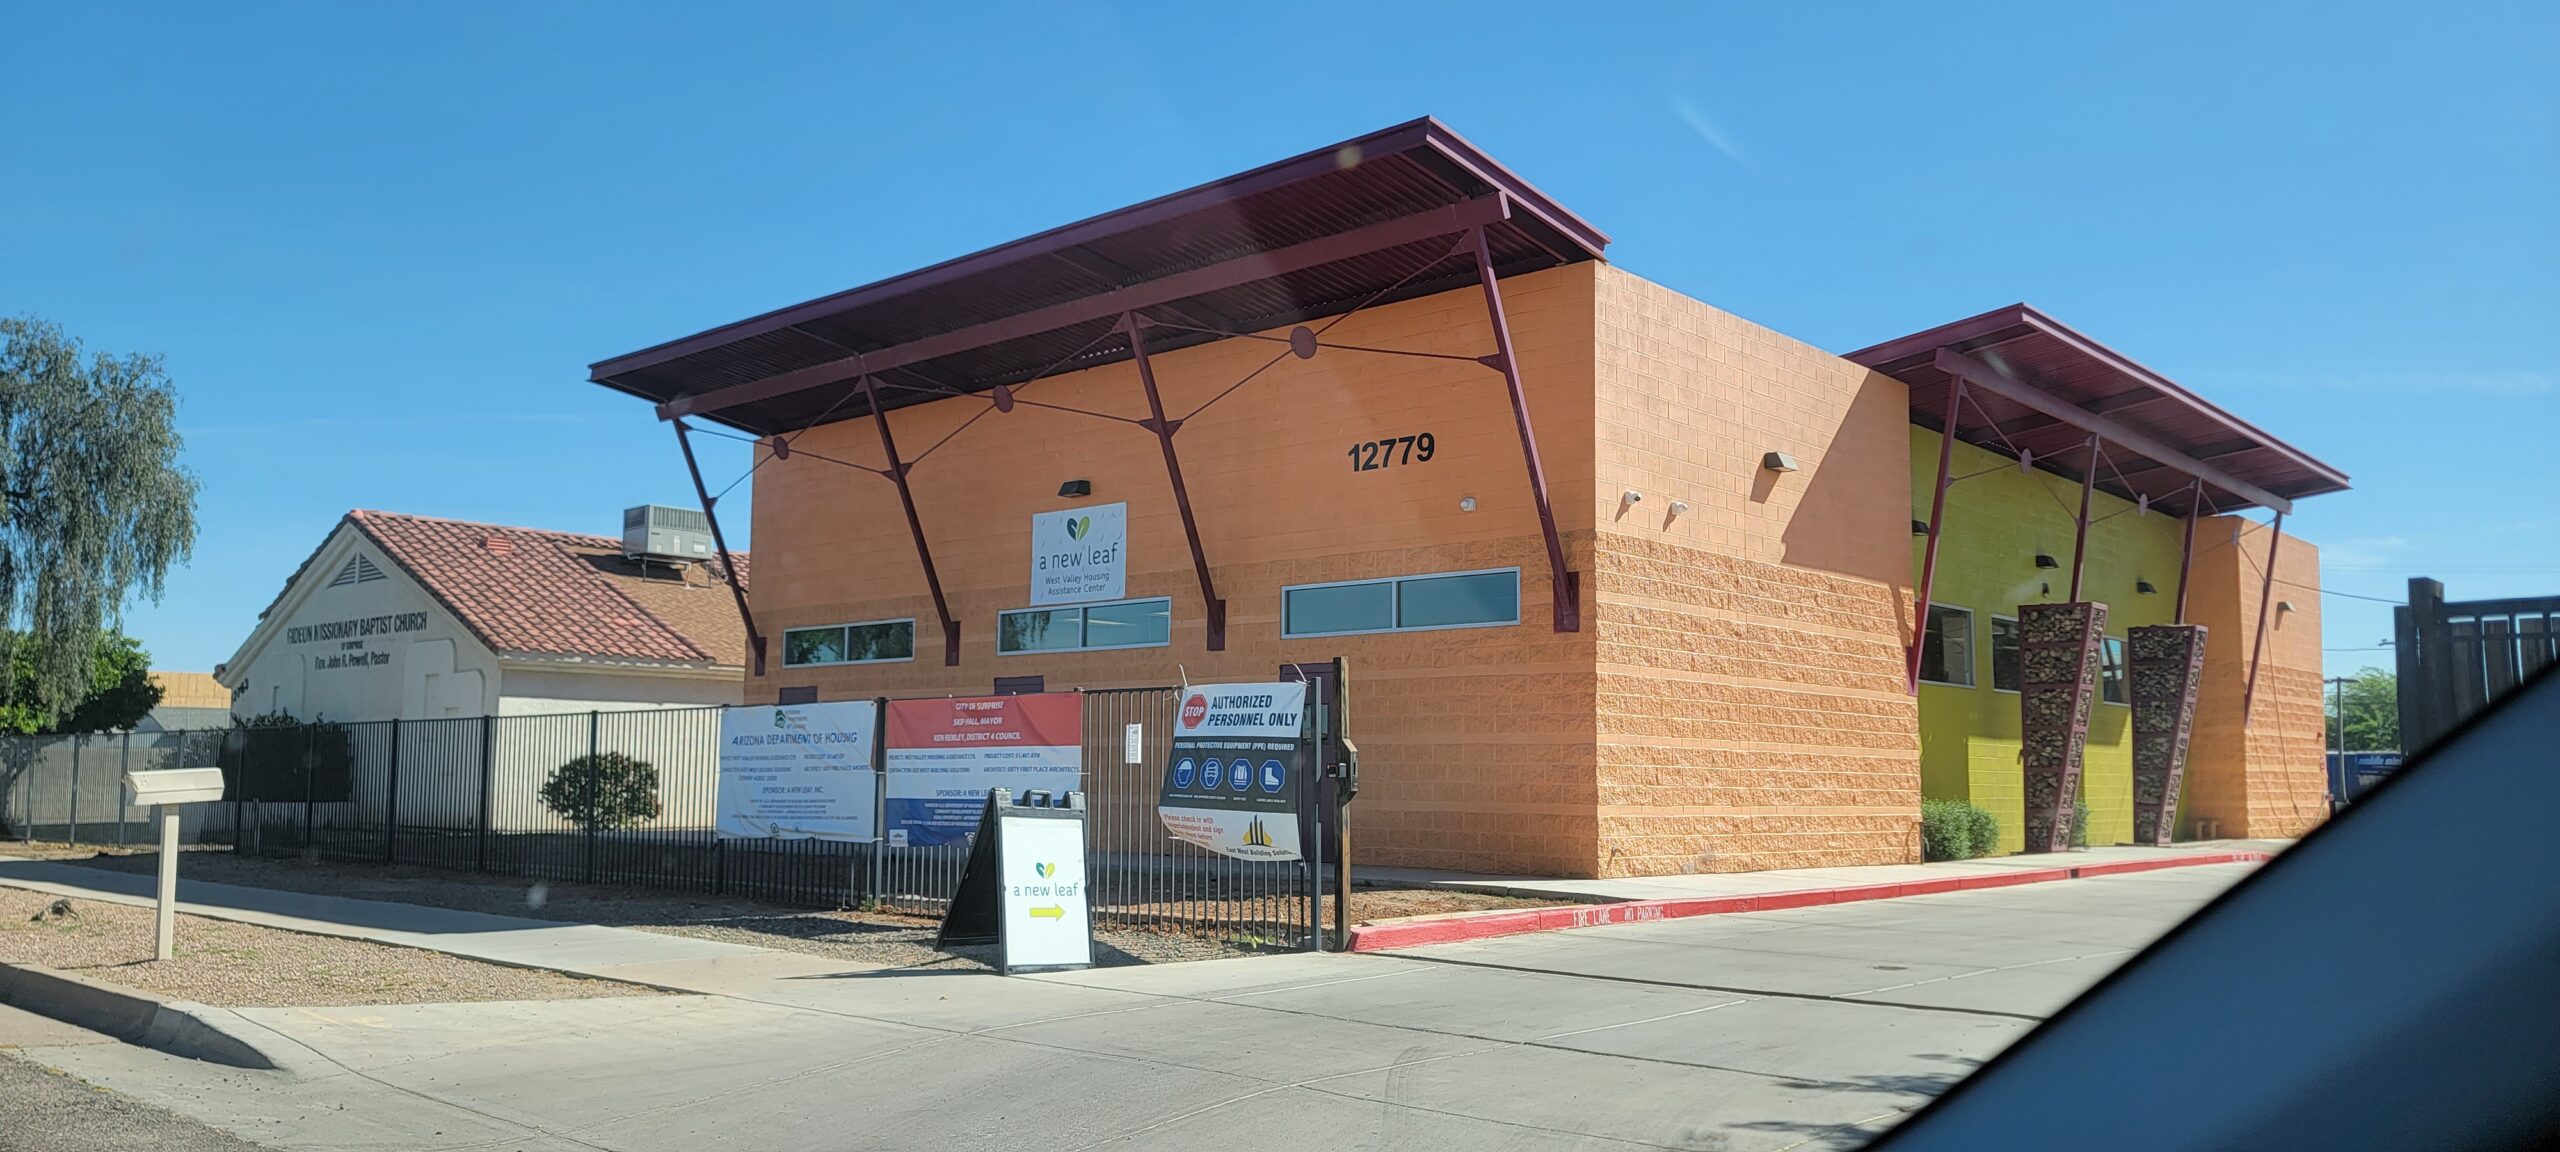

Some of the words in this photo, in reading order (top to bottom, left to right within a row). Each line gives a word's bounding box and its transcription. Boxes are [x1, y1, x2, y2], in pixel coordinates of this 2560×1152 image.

[1348, 432, 1435, 472] 12779
[1040, 555, 1047, 570] a
[1052, 551, 1082, 569] new
[1088, 542, 1118, 566] leaf
[1045, 576, 1061, 585] West
[1063, 574, 1082, 585] Valley
[1084, 572, 1110, 582] Housing
[1048, 586, 1082, 596] Assistance
[1084, 584, 1106, 593] Center
[360, 615, 393, 637] BAPTIST
[394, 611, 428, 633] CHURCH
[327, 654, 341, 669] John
[371, 652, 390, 666] Pastor
[955, 702, 968, 711] CITY
[976, 701, 1004, 710] SURPRISE
[1211, 694, 1273, 710] AUTHORIZED
[1184, 706, 1205, 718] STOP
[980, 716, 1003, 725] MAYOR
[1207, 712, 1265, 727] PERSONNEL
[1268, 712, 1298, 727] ONLY
[732, 735, 765, 746] ARIZONA
[766, 733, 812, 746] DEPARTMENT
[813, 733, 822, 744] OF
[825, 732, 858, 744] HOUSING
[966, 732, 990, 742] DISTRICT
[990, 732, 995, 740] 4
[995, 732, 1021, 740] COUNCIL
[1196, 742, 1223, 750] PROTECTIVE
[1224, 742, 1252, 750] EQUIPMENT
[1252, 742, 1266, 751] (PPE)
[1268, 743, 1295, 751] REQUIRED
[969, 789, 982, 797] NEW
[1181, 815, 1196, 823] check
[1202, 816, 1214, 824] with
[1212, 826, 1224, 834] sign
[1226, 846, 1236, 854] East
[1250, 849, 1272, 857] Building
[1013, 886, 1021, 897] a
[1024, 886, 1050, 897] new
[1054, 882, 1079, 897] leaf
[1573, 909, 1590, 928] FIRE
[1593, 908, 1612, 925] LANE
[1624, 907, 1634, 921] NO
[1637, 906, 1664, 921] PARKING
